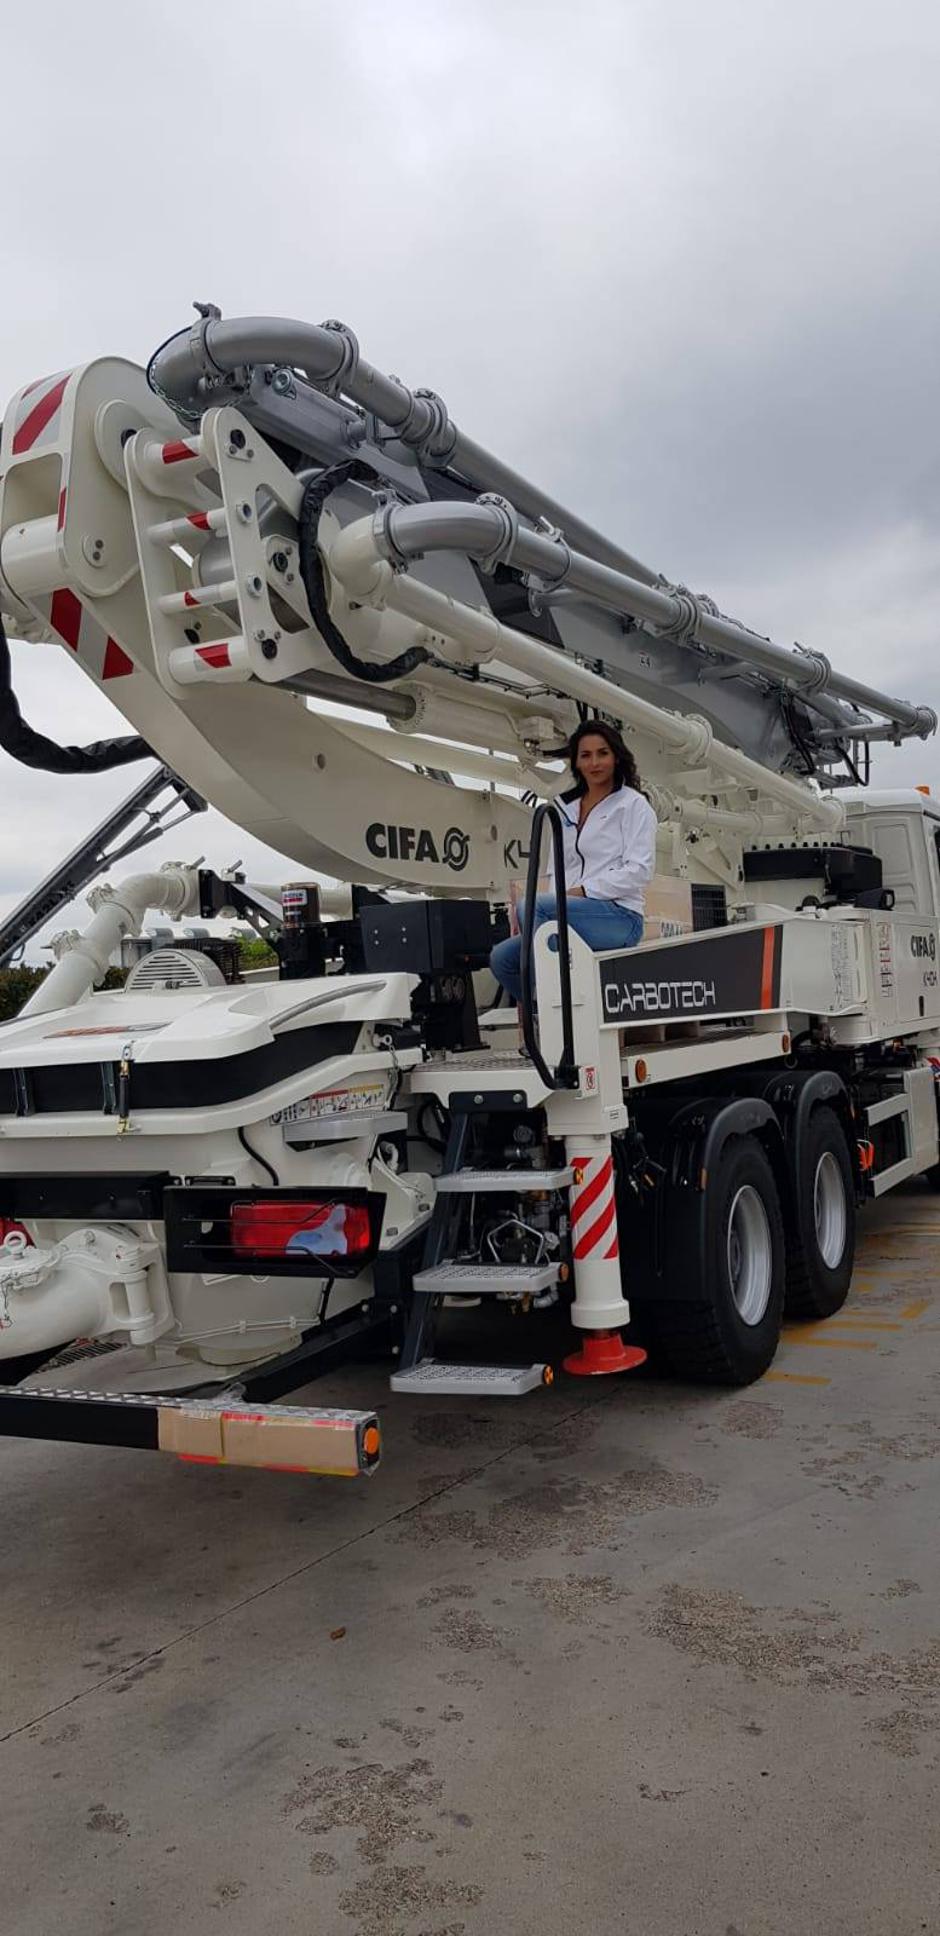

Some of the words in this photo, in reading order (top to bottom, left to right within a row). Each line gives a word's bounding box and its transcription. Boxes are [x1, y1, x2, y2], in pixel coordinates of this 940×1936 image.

[365, 823, 440, 864] CIFA
[910, 934, 929, 958] CIFA
[604, 981, 716, 1014] CARBOTECH
